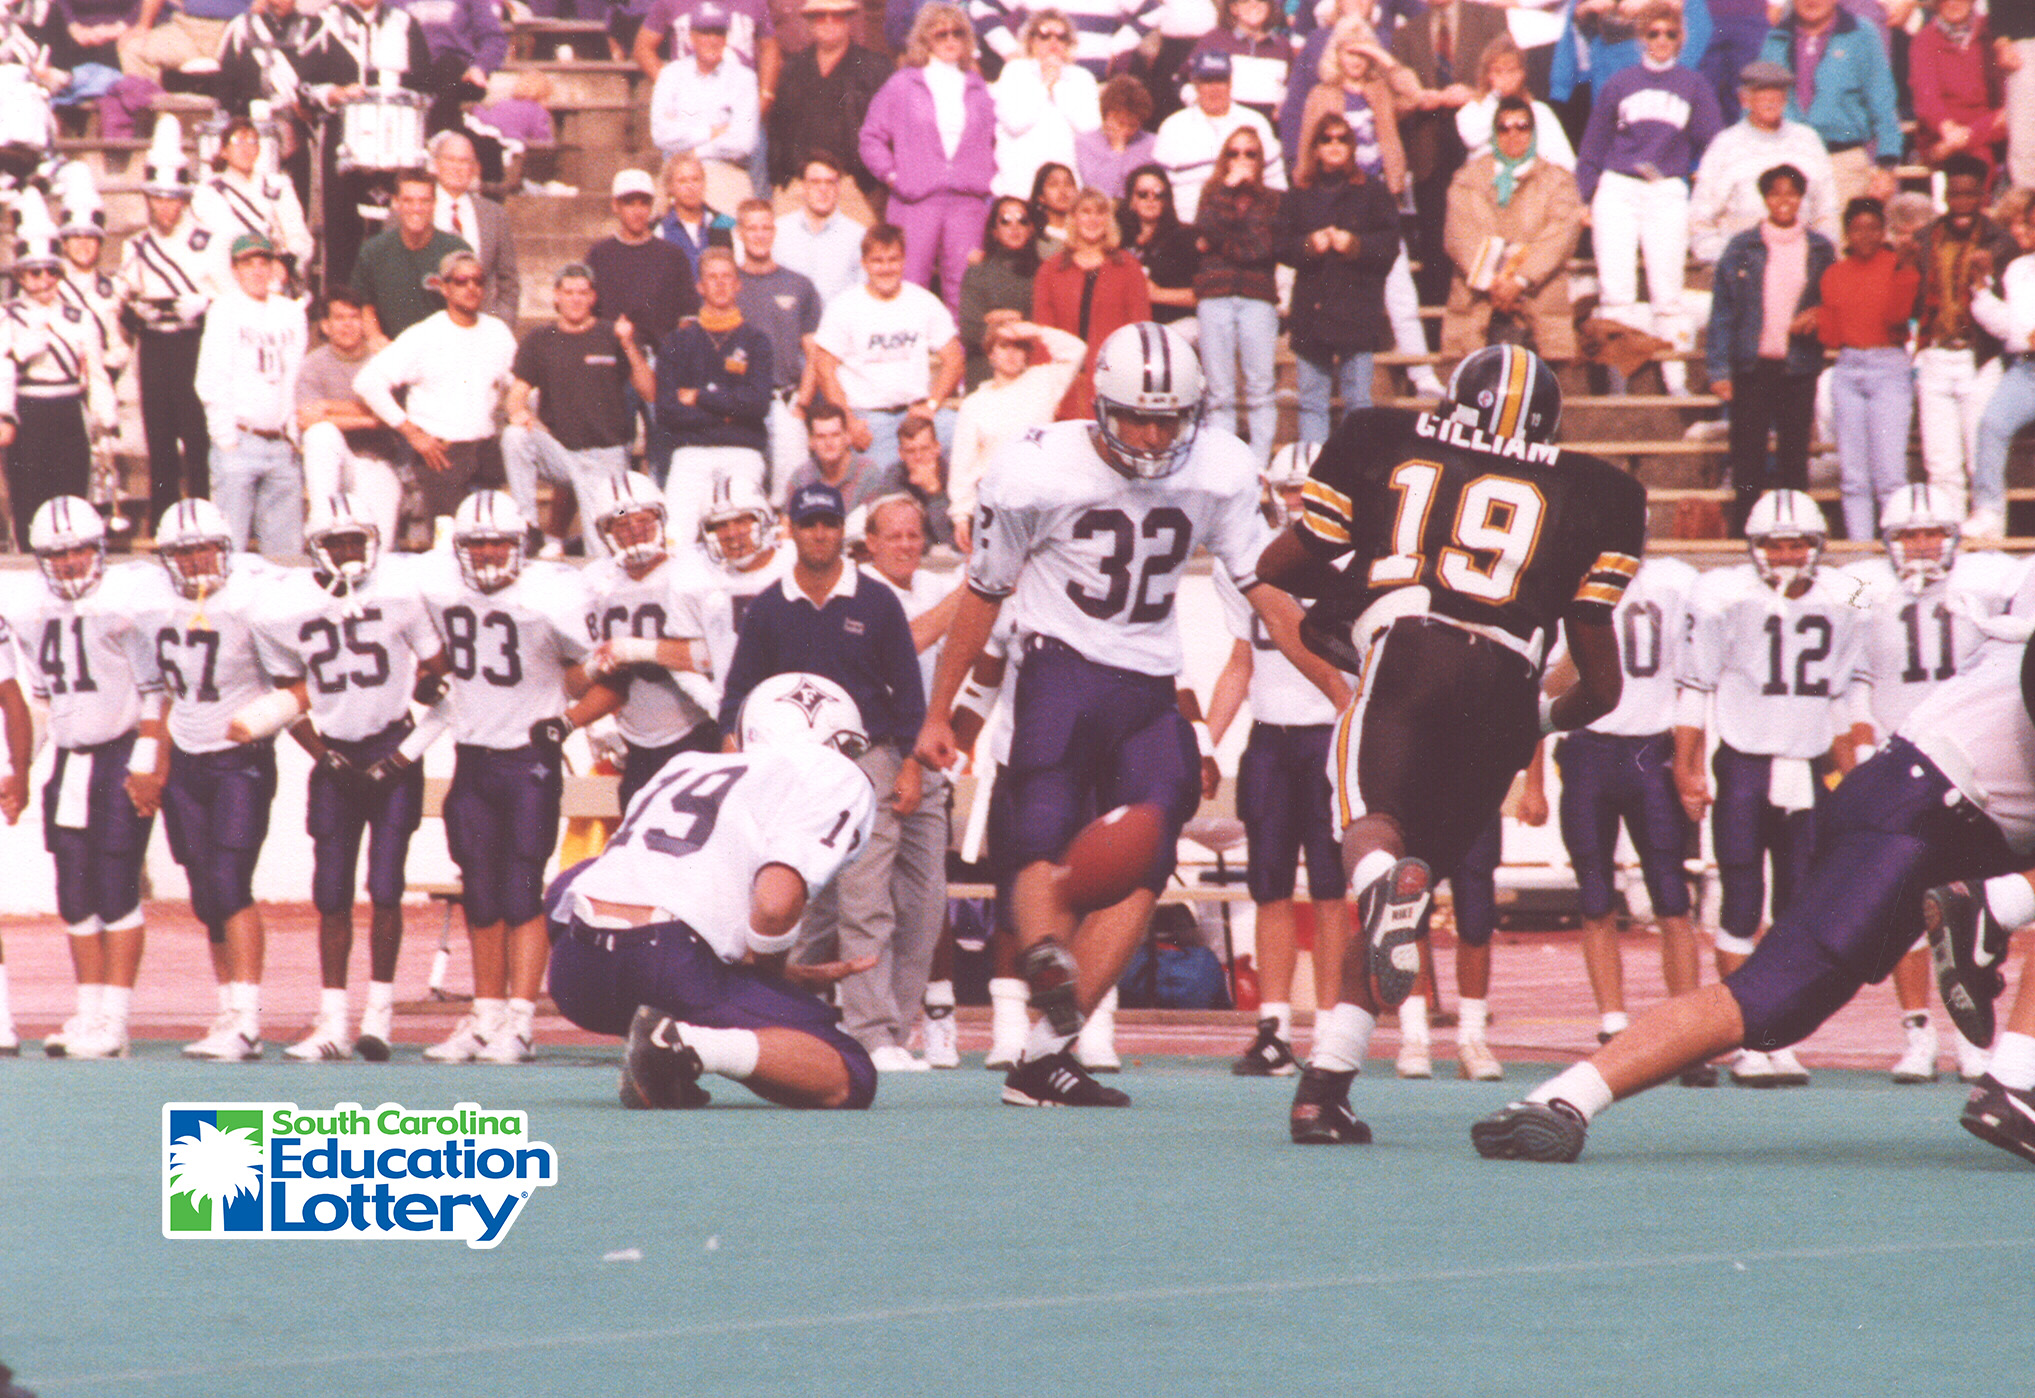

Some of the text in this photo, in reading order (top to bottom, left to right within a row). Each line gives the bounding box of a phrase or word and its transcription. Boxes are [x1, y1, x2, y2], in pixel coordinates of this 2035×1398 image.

[1415, 411, 1561, 467] GILLIAM
[1065, 507, 1194, 624] 32
[1367, 457, 1548, 606] 19
[39, 616, 98, 694] 41
[155, 626, 220, 703] 67
[298, 607, 391, 694] 25
[443, 605, 523, 688] 83
[1762, 614, 1832, 697] 12
[1899, 600, 1957, 684] 11
[603, 765, 748, 858] 19
